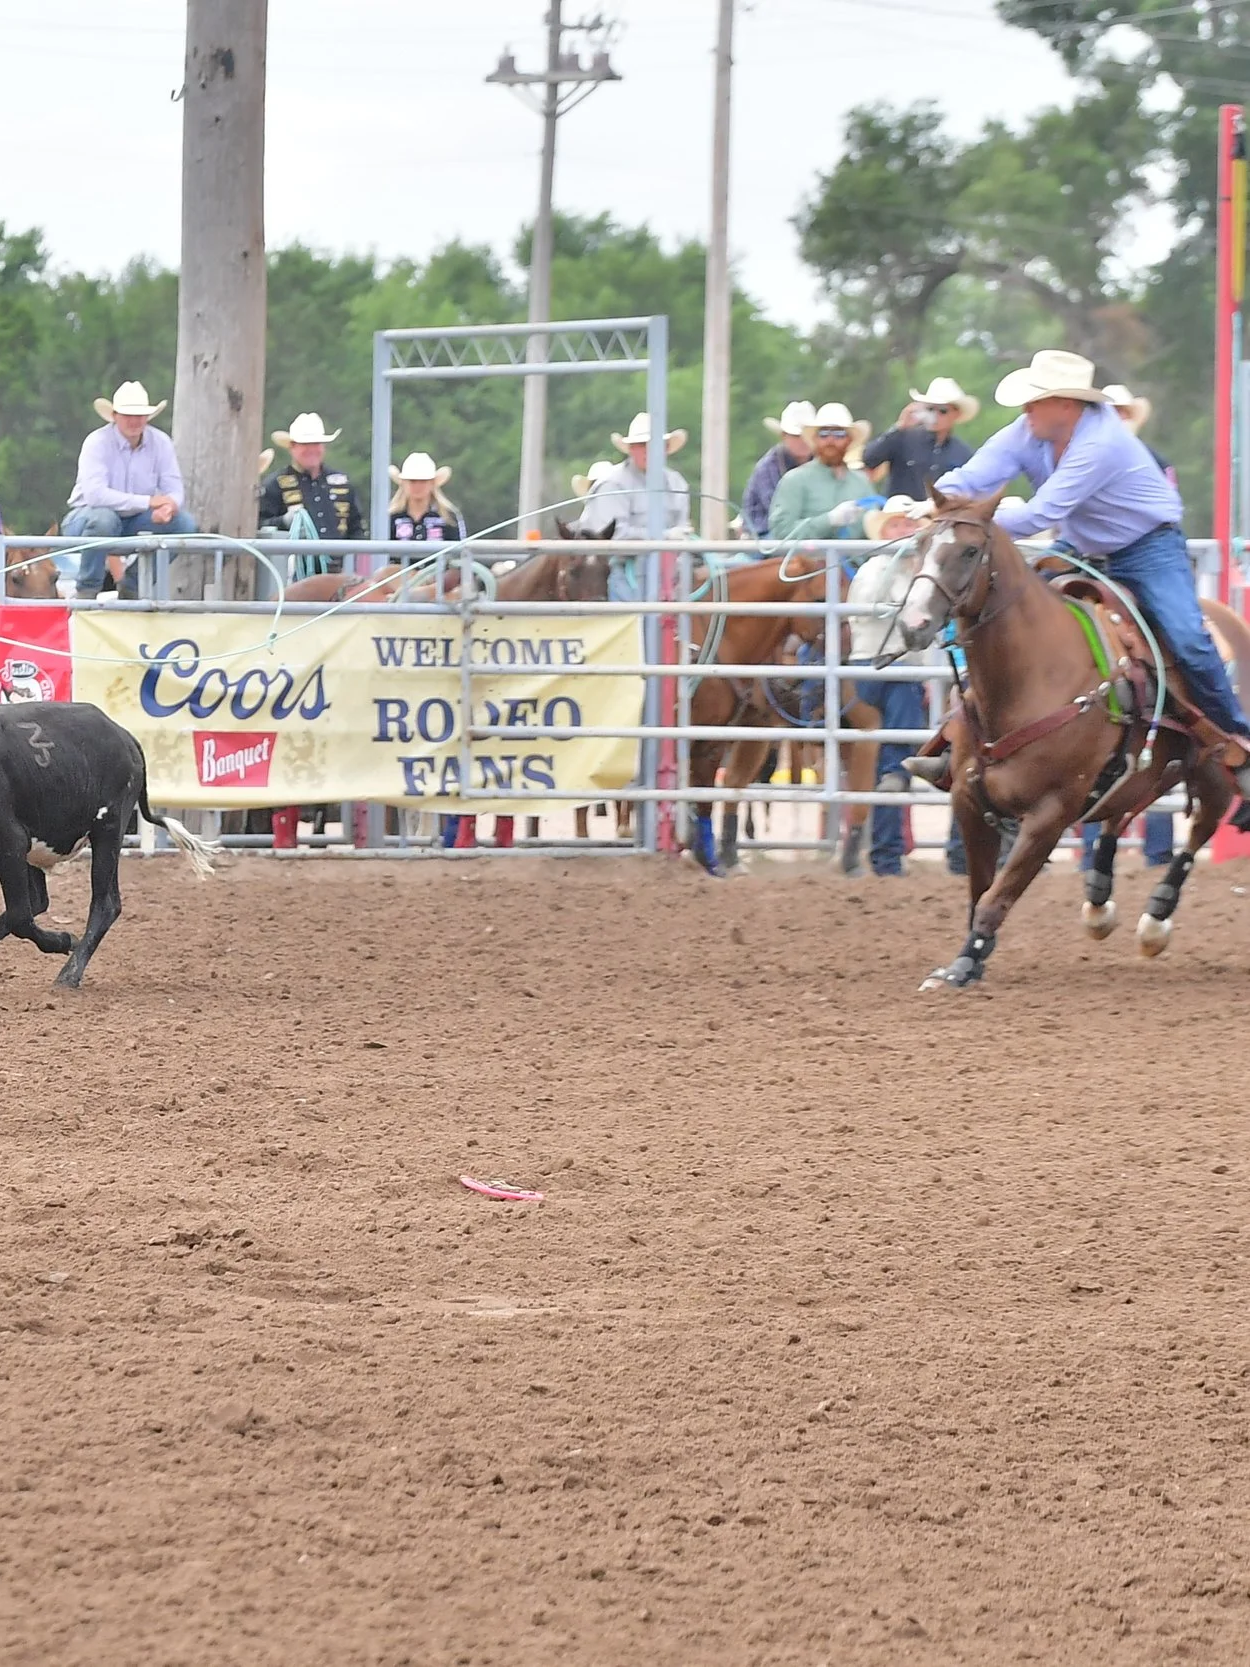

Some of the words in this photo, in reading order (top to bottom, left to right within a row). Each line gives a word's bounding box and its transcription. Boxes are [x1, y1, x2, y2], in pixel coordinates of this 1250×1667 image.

[371, 636, 587, 667] WELCOME
[138, 638, 332, 720] Coors
[201, 736, 271, 783] Banquet
